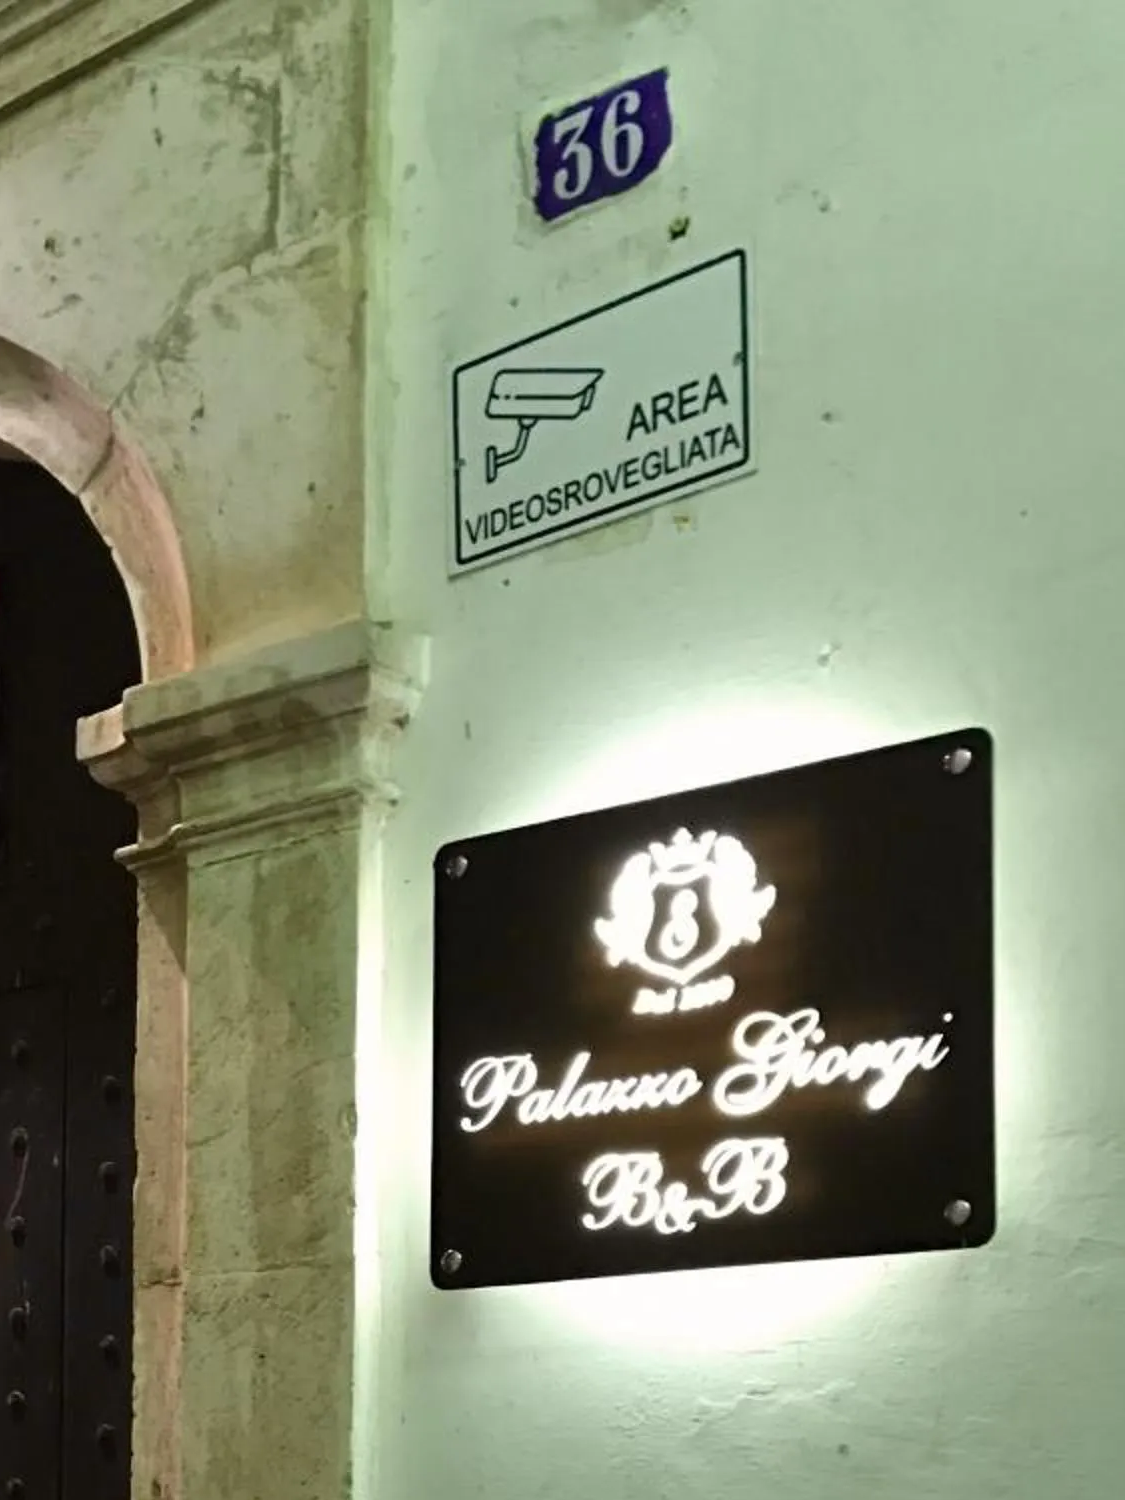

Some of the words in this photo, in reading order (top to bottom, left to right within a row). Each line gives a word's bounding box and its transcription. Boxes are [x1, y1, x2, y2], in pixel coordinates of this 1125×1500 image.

[554, 90, 644, 199] 36
[626, 373, 729, 442] AREA
[464, 423, 741, 545] VIDEOSROVEGLIATA
[460, 1051, 703, 1133] Palazzo
[712, 1007, 953, 1118] Giorgi
[581, 1136, 790, 1235] B&B
